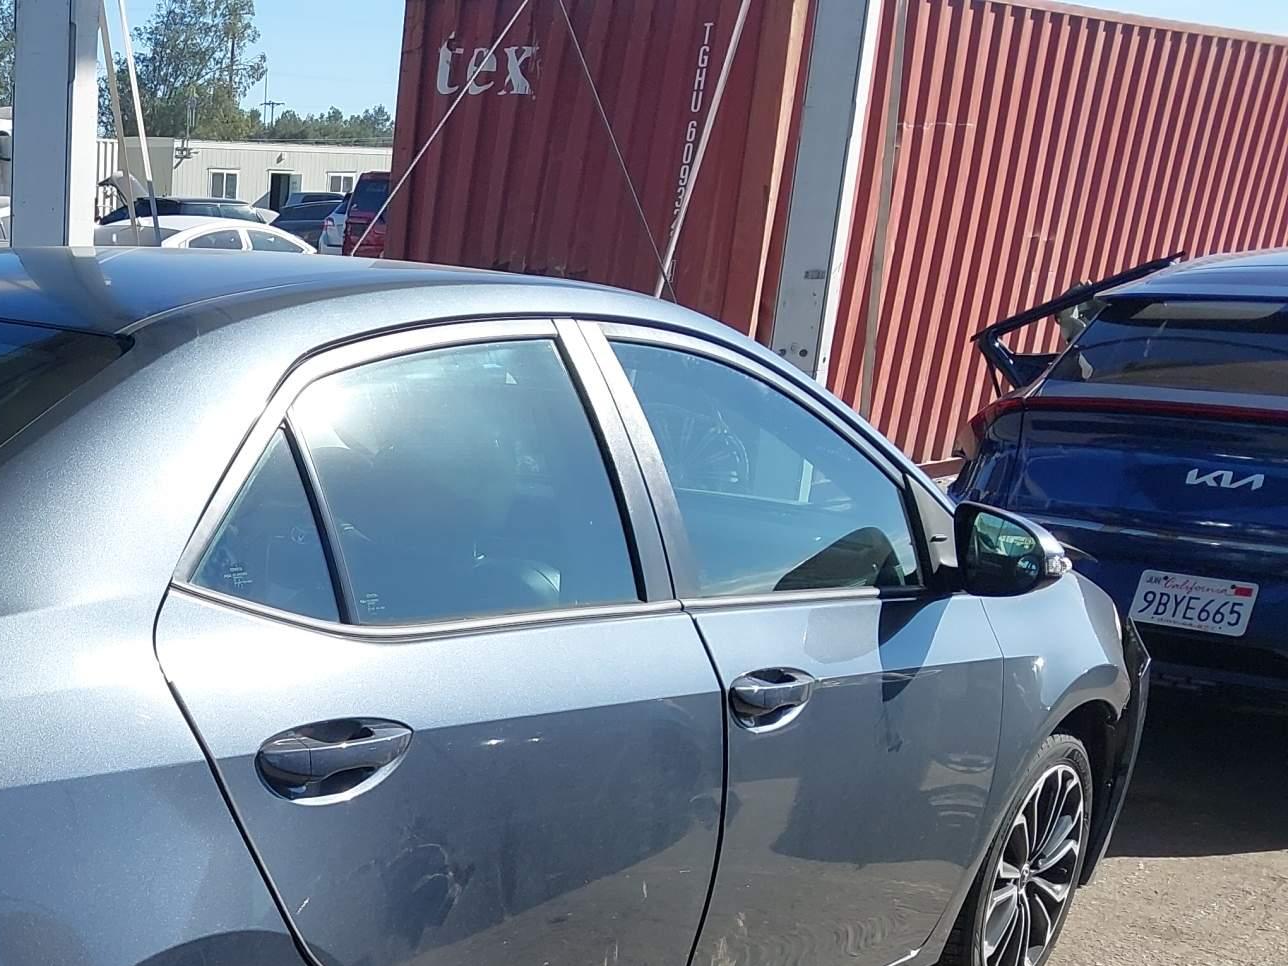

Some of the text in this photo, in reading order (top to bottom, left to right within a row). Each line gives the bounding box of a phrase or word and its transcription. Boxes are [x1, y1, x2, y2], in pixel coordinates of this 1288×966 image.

[436, 31, 539, 97] tex
[669, 22, 714, 237] TGHU 6093
[1185, 468, 1265, 491] KIA
[1163, 575, 1230, 595] California
[1137, 590, 1244, 627] 9BYE665
